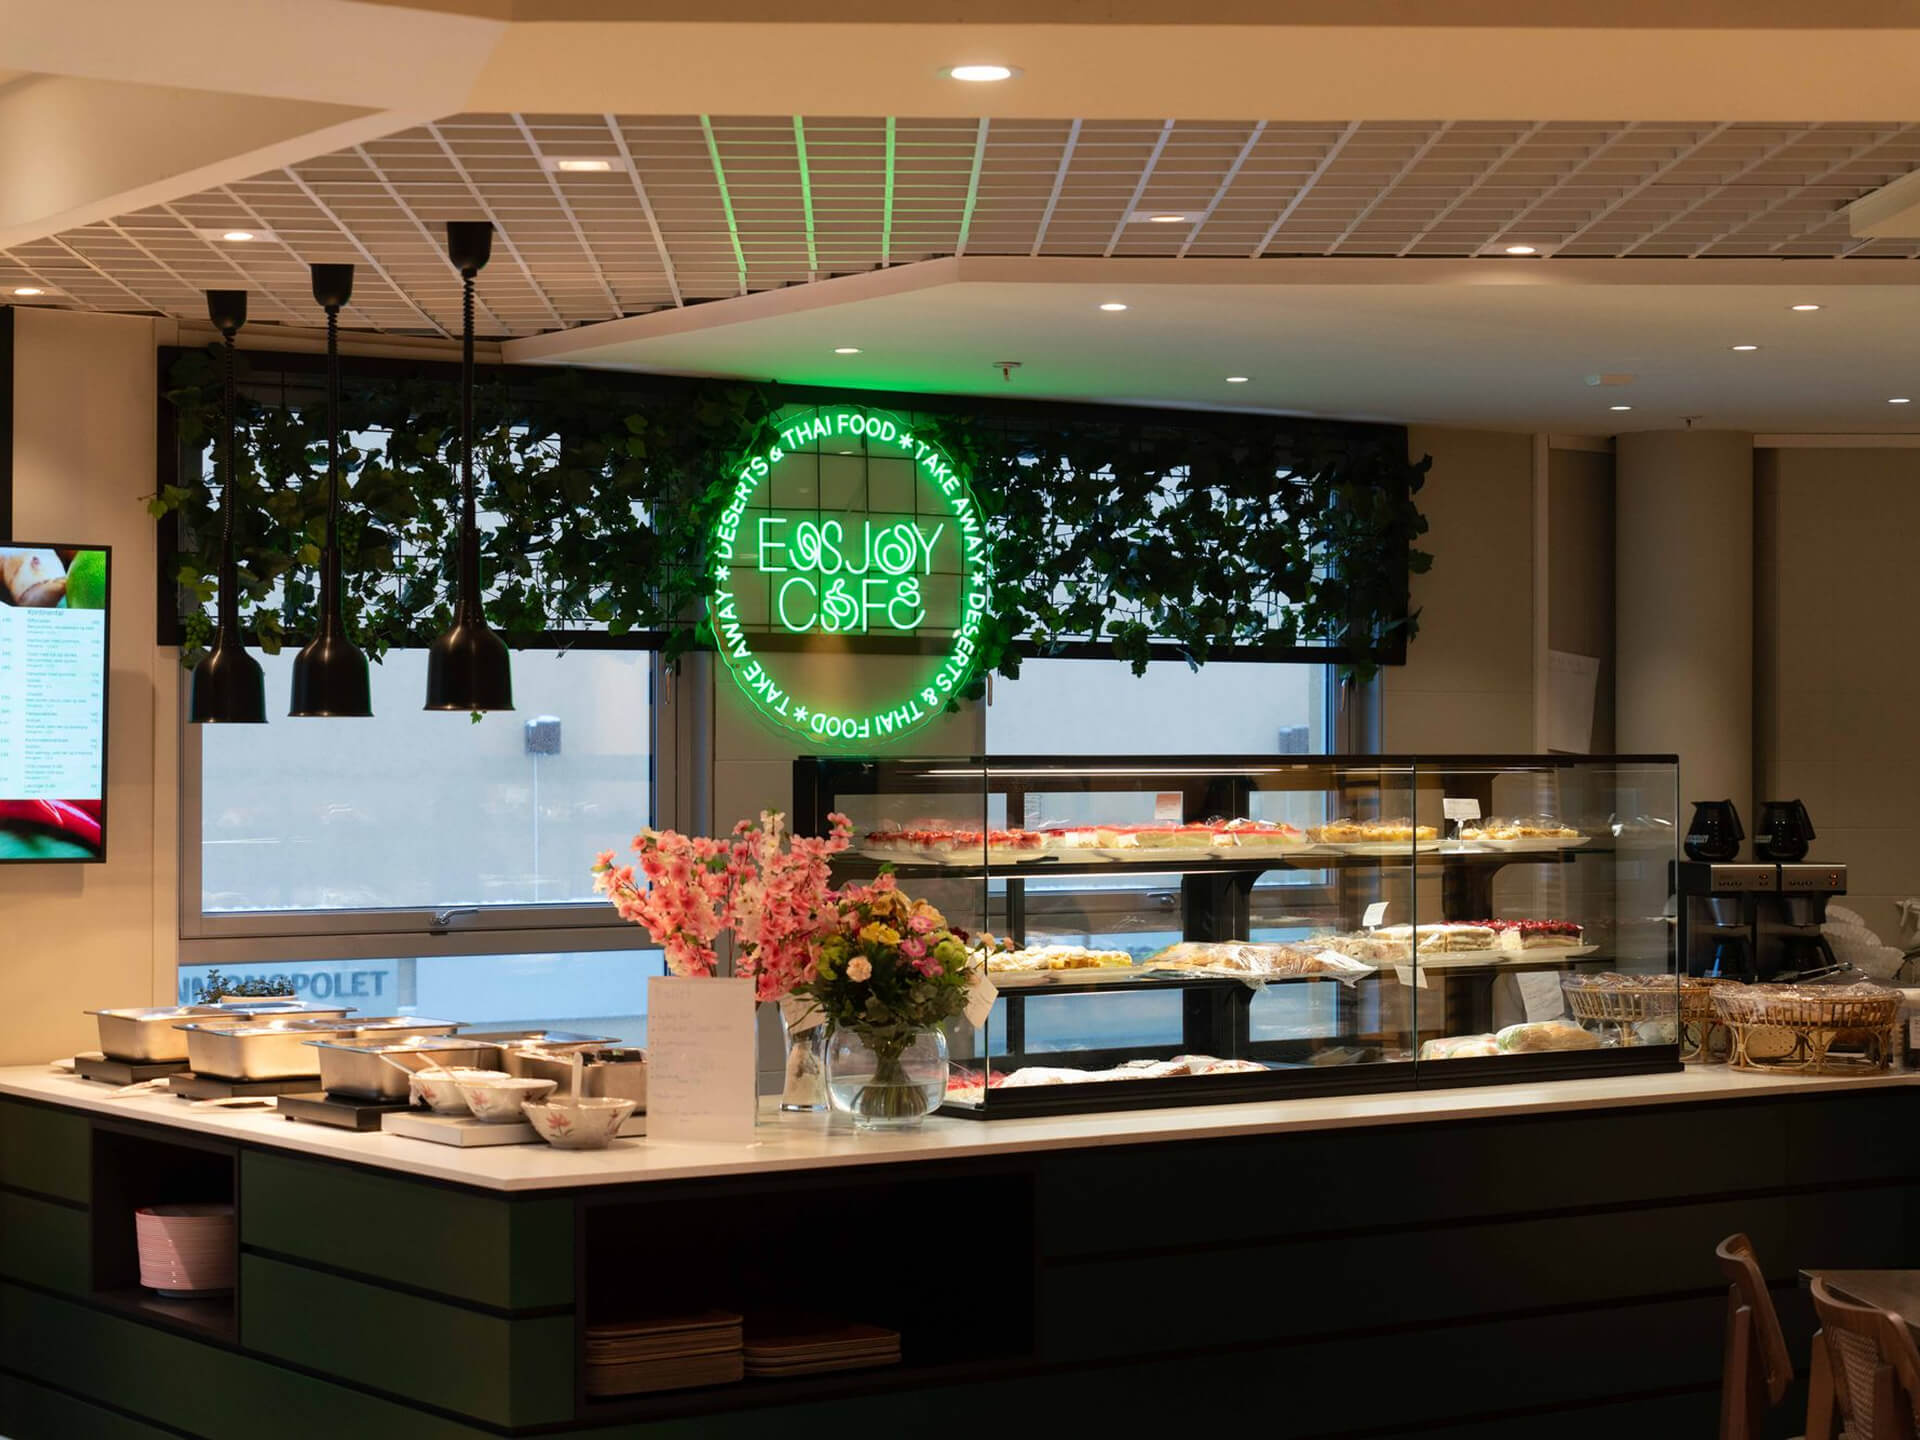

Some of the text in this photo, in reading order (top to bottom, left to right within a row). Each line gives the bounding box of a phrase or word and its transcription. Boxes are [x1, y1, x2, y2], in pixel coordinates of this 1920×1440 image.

[715, 413, 897, 559] DESERTS & THAI FOOD
[914, 439, 987, 568] TAKE AWAY
[714, 588, 792, 719] TAKE AWAY
[809, 592, 987, 740] DESERTS & THAI FOOD
